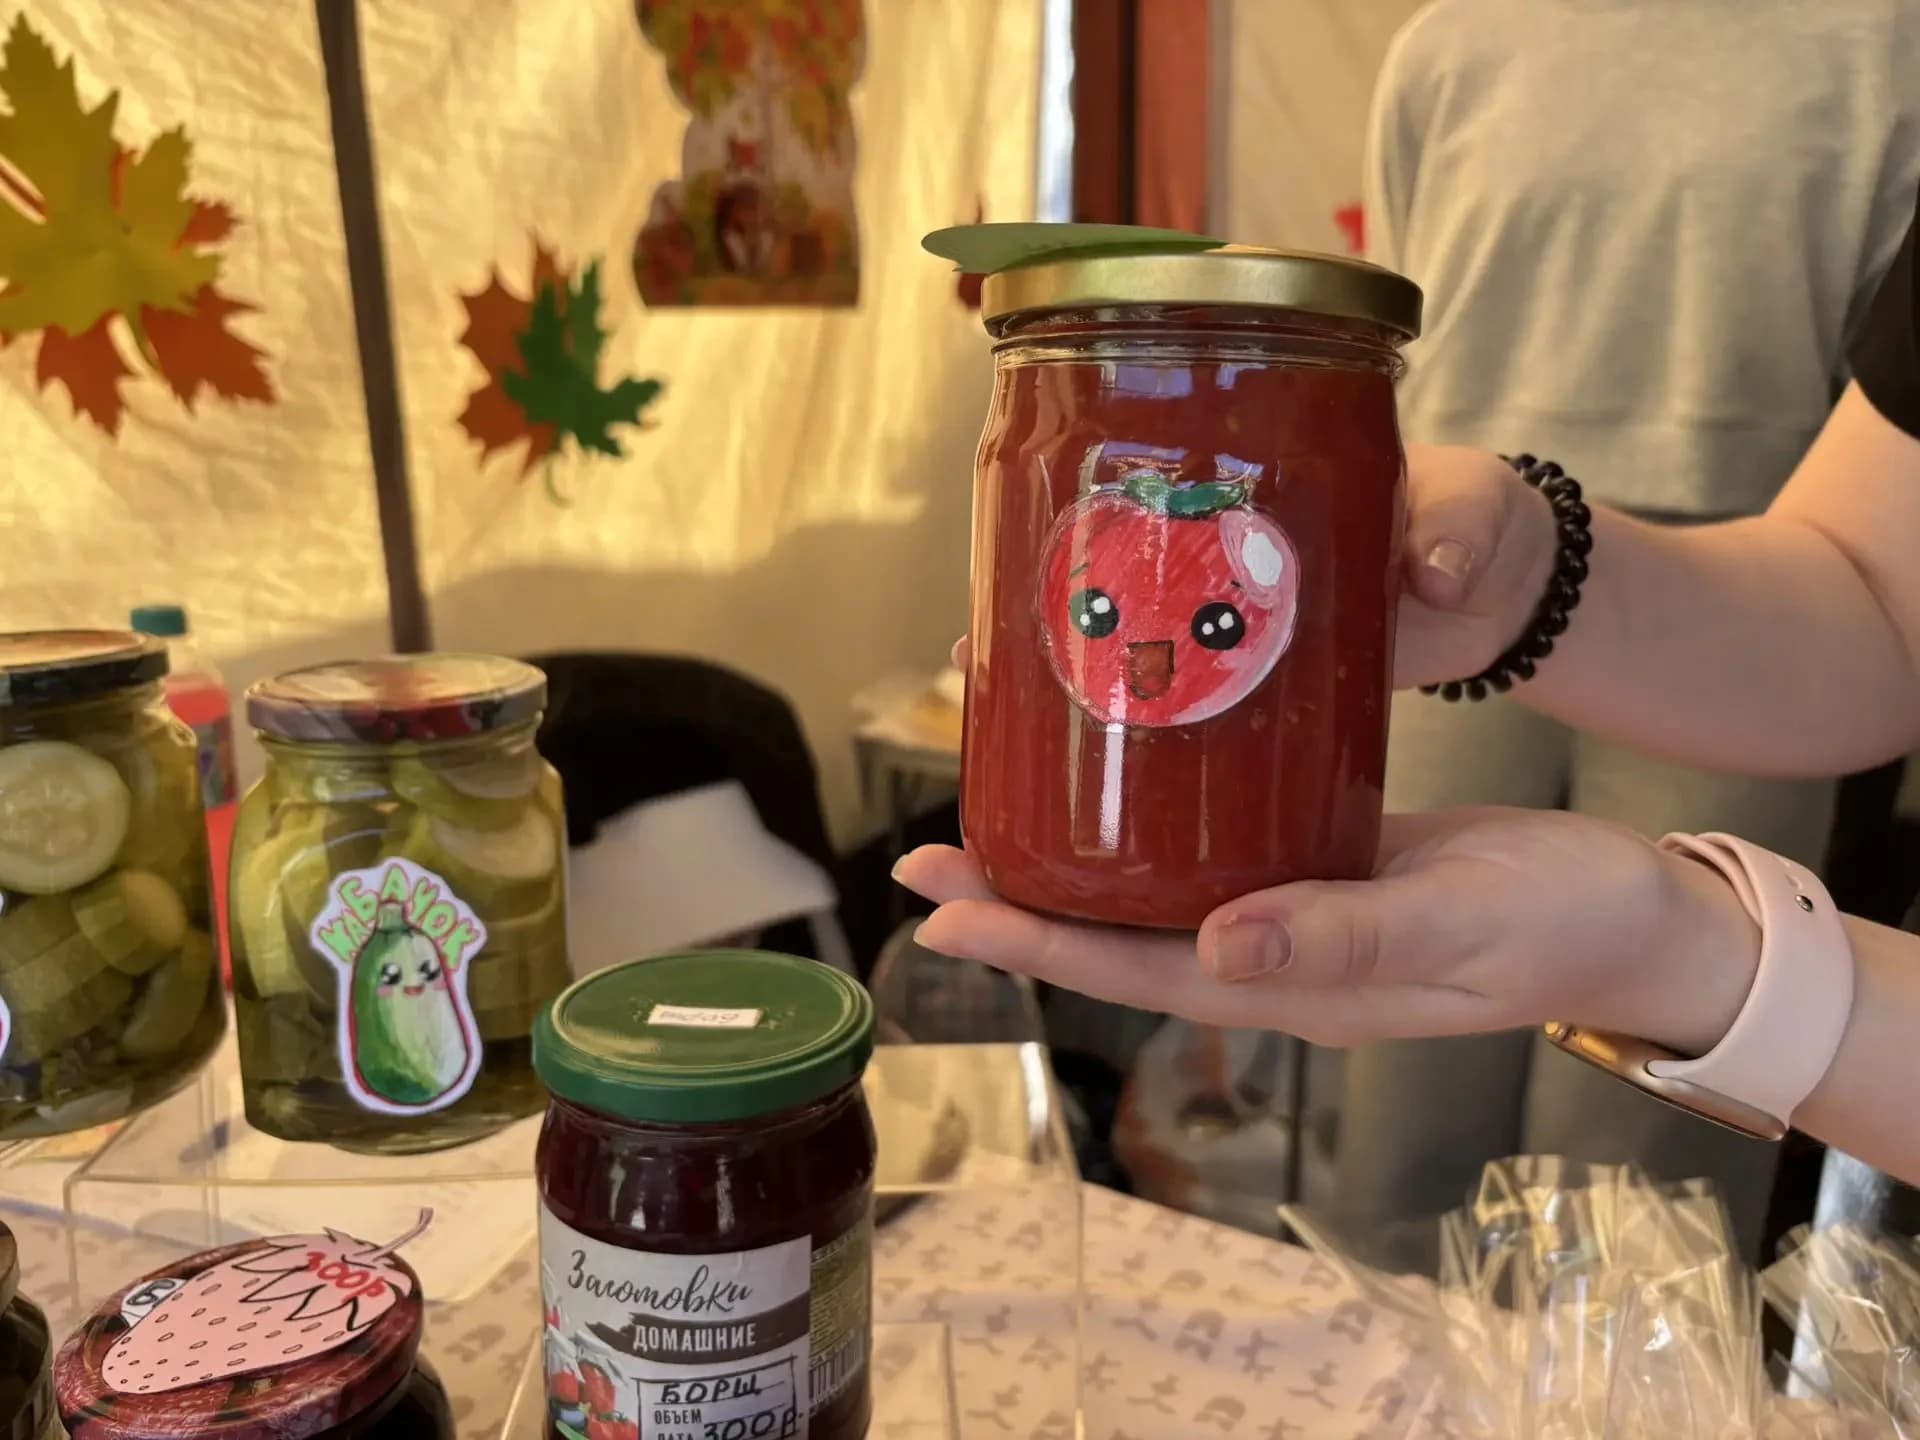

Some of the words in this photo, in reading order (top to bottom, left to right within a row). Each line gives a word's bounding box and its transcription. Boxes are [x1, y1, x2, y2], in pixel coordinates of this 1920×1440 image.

[568, 1249, 752, 1314] Заготовки
[633, 1322, 757, 1352] ДОМАШНИЕ
[661, 1374, 761, 1403] БОРЩ
[654, 1408, 702, 1425] ОБЪЕМ
